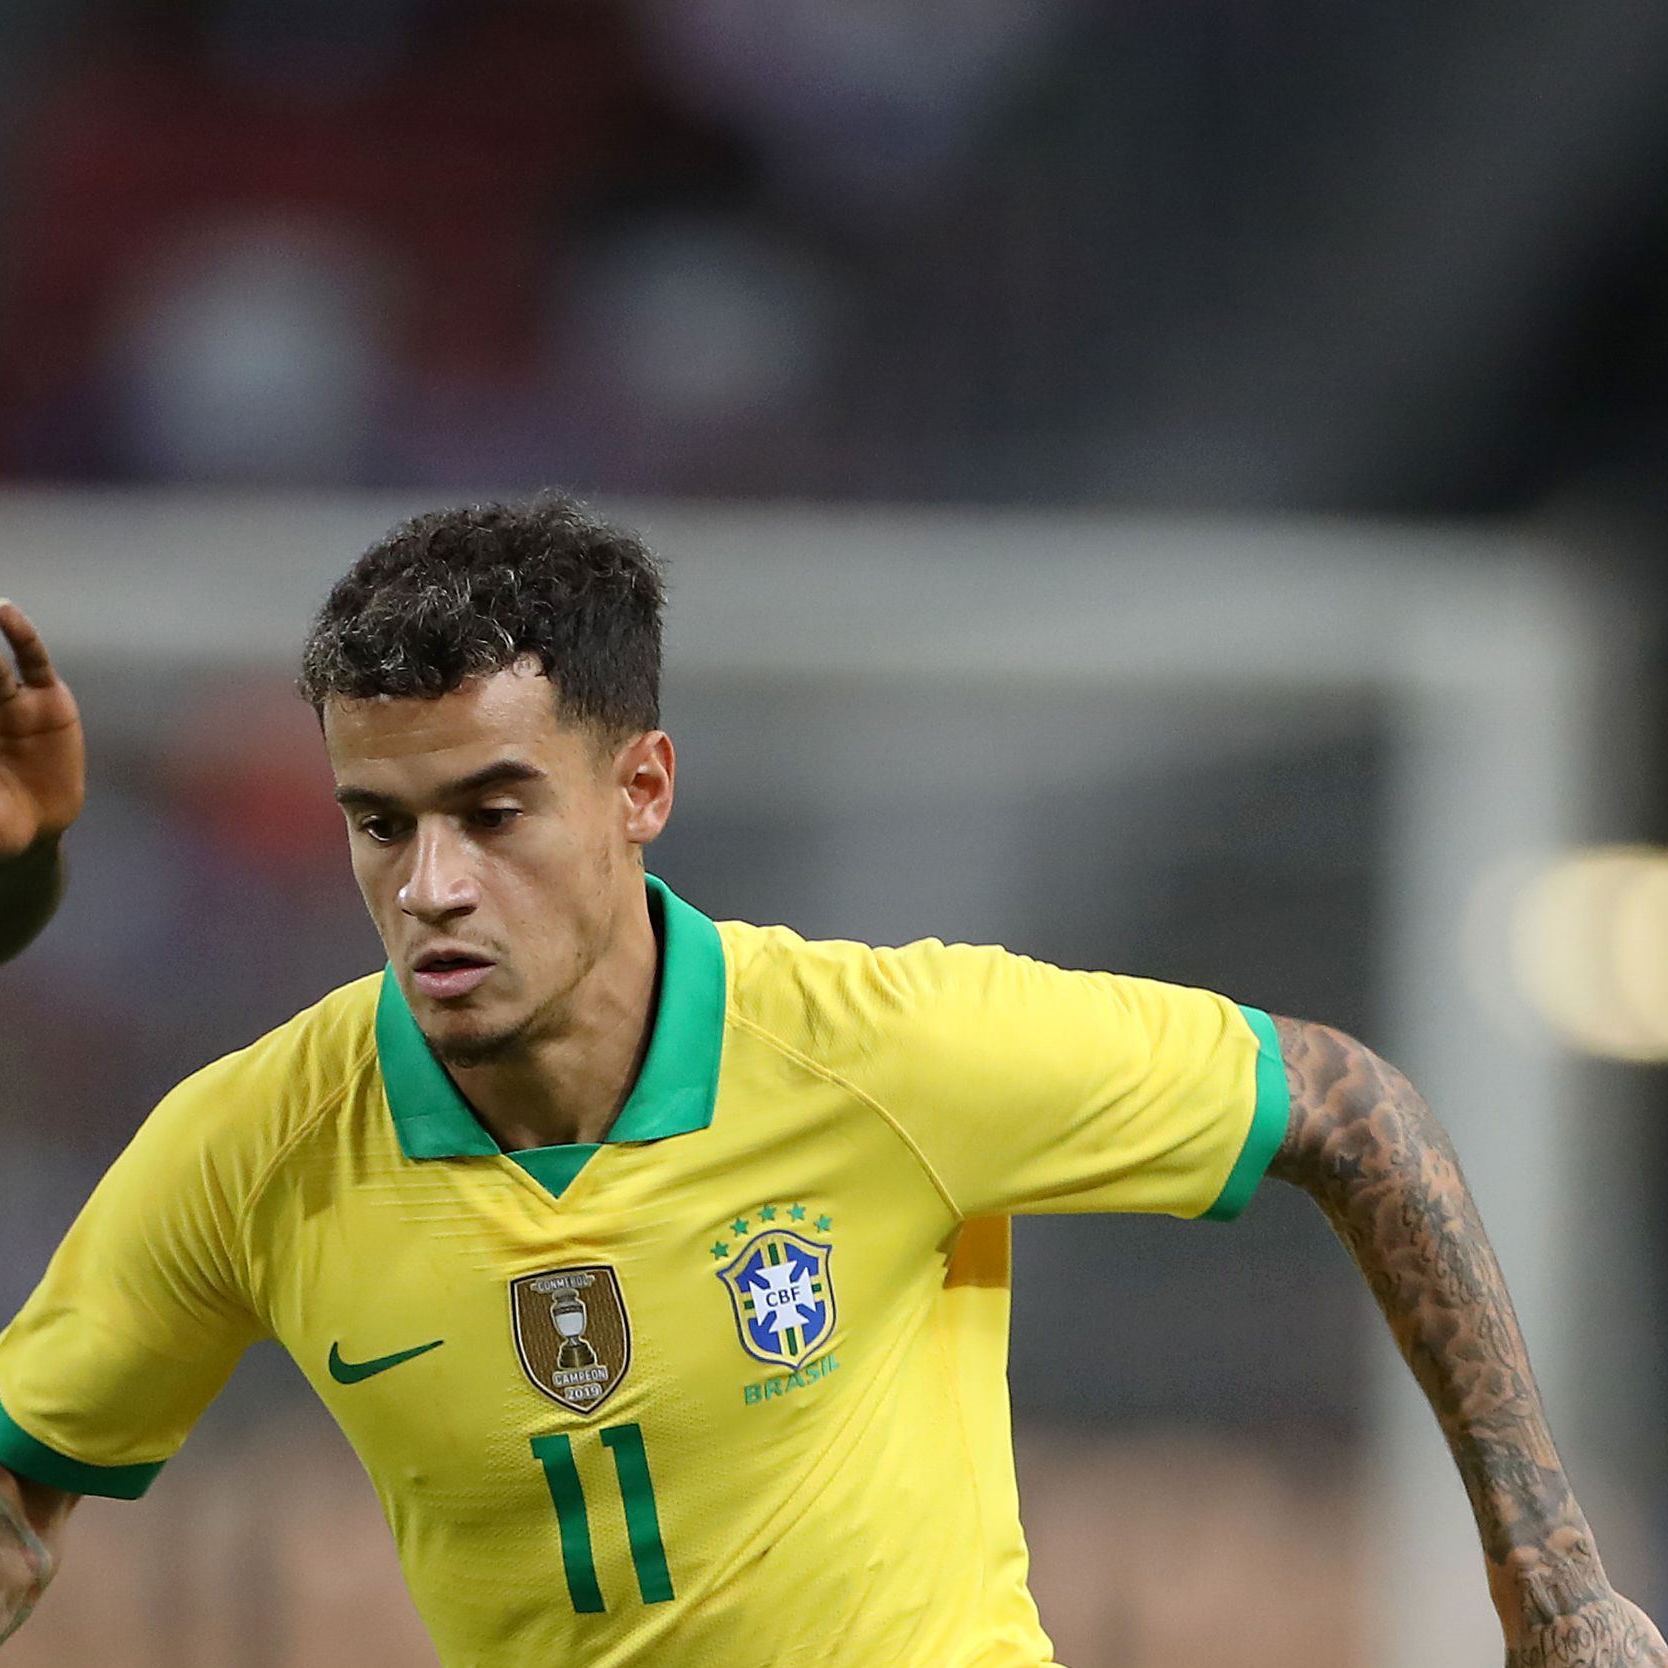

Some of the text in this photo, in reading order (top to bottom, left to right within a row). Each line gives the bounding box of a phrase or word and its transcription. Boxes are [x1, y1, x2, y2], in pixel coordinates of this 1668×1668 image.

[765, 1286, 801, 1307] CBF
[566, 1385, 602, 1400] 2019
[744, 1354, 840, 1405] BRASIL
[531, 1423, 675, 1613] 11
